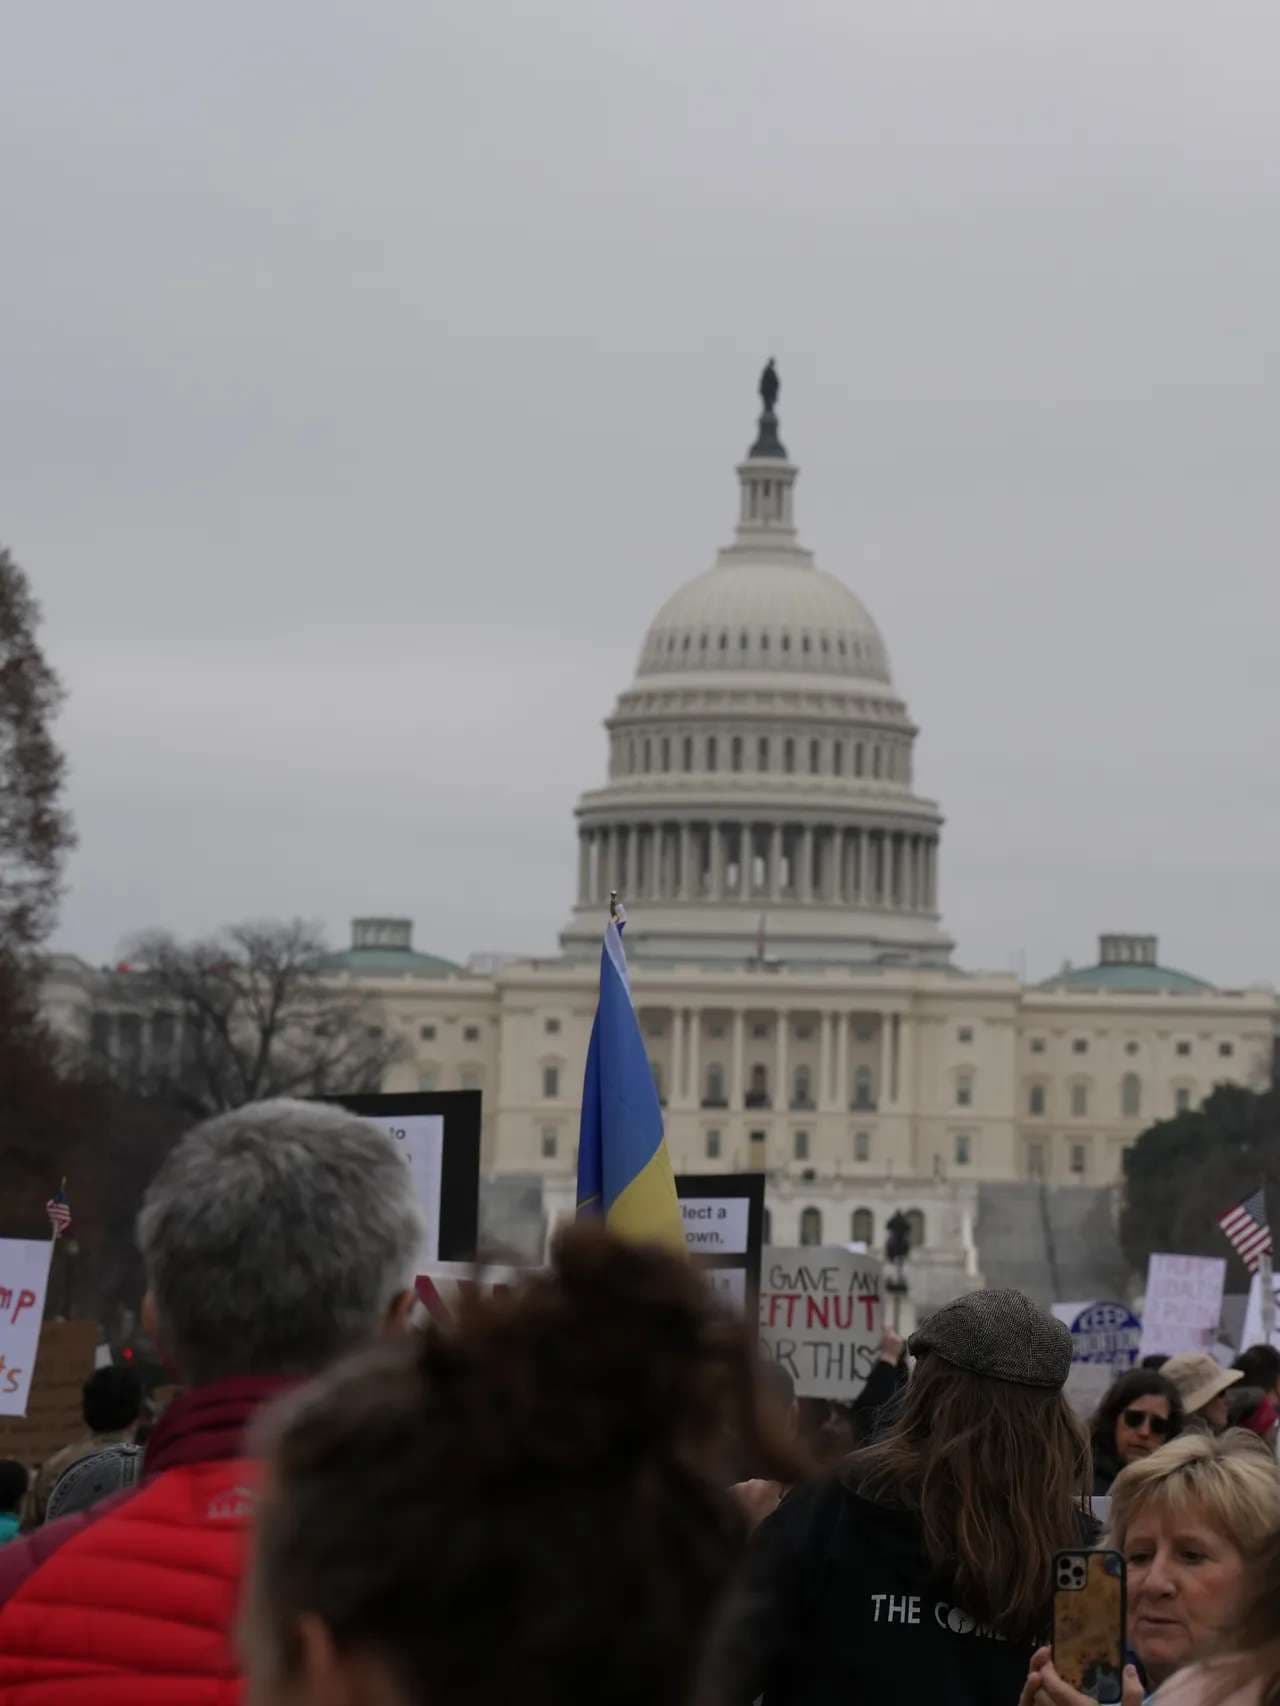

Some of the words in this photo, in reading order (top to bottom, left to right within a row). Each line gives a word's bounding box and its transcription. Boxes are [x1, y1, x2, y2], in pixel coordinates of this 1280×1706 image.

[680, 1204, 712, 1220] lect
[686, 1230, 724, 1245] own,
[769, 1263, 840, 1293] GAVE
[806, 1294, 880, 1332] NUT
[802, 1341, 883, 1383] THIS
[871, 1594, 921, 1625] THE
